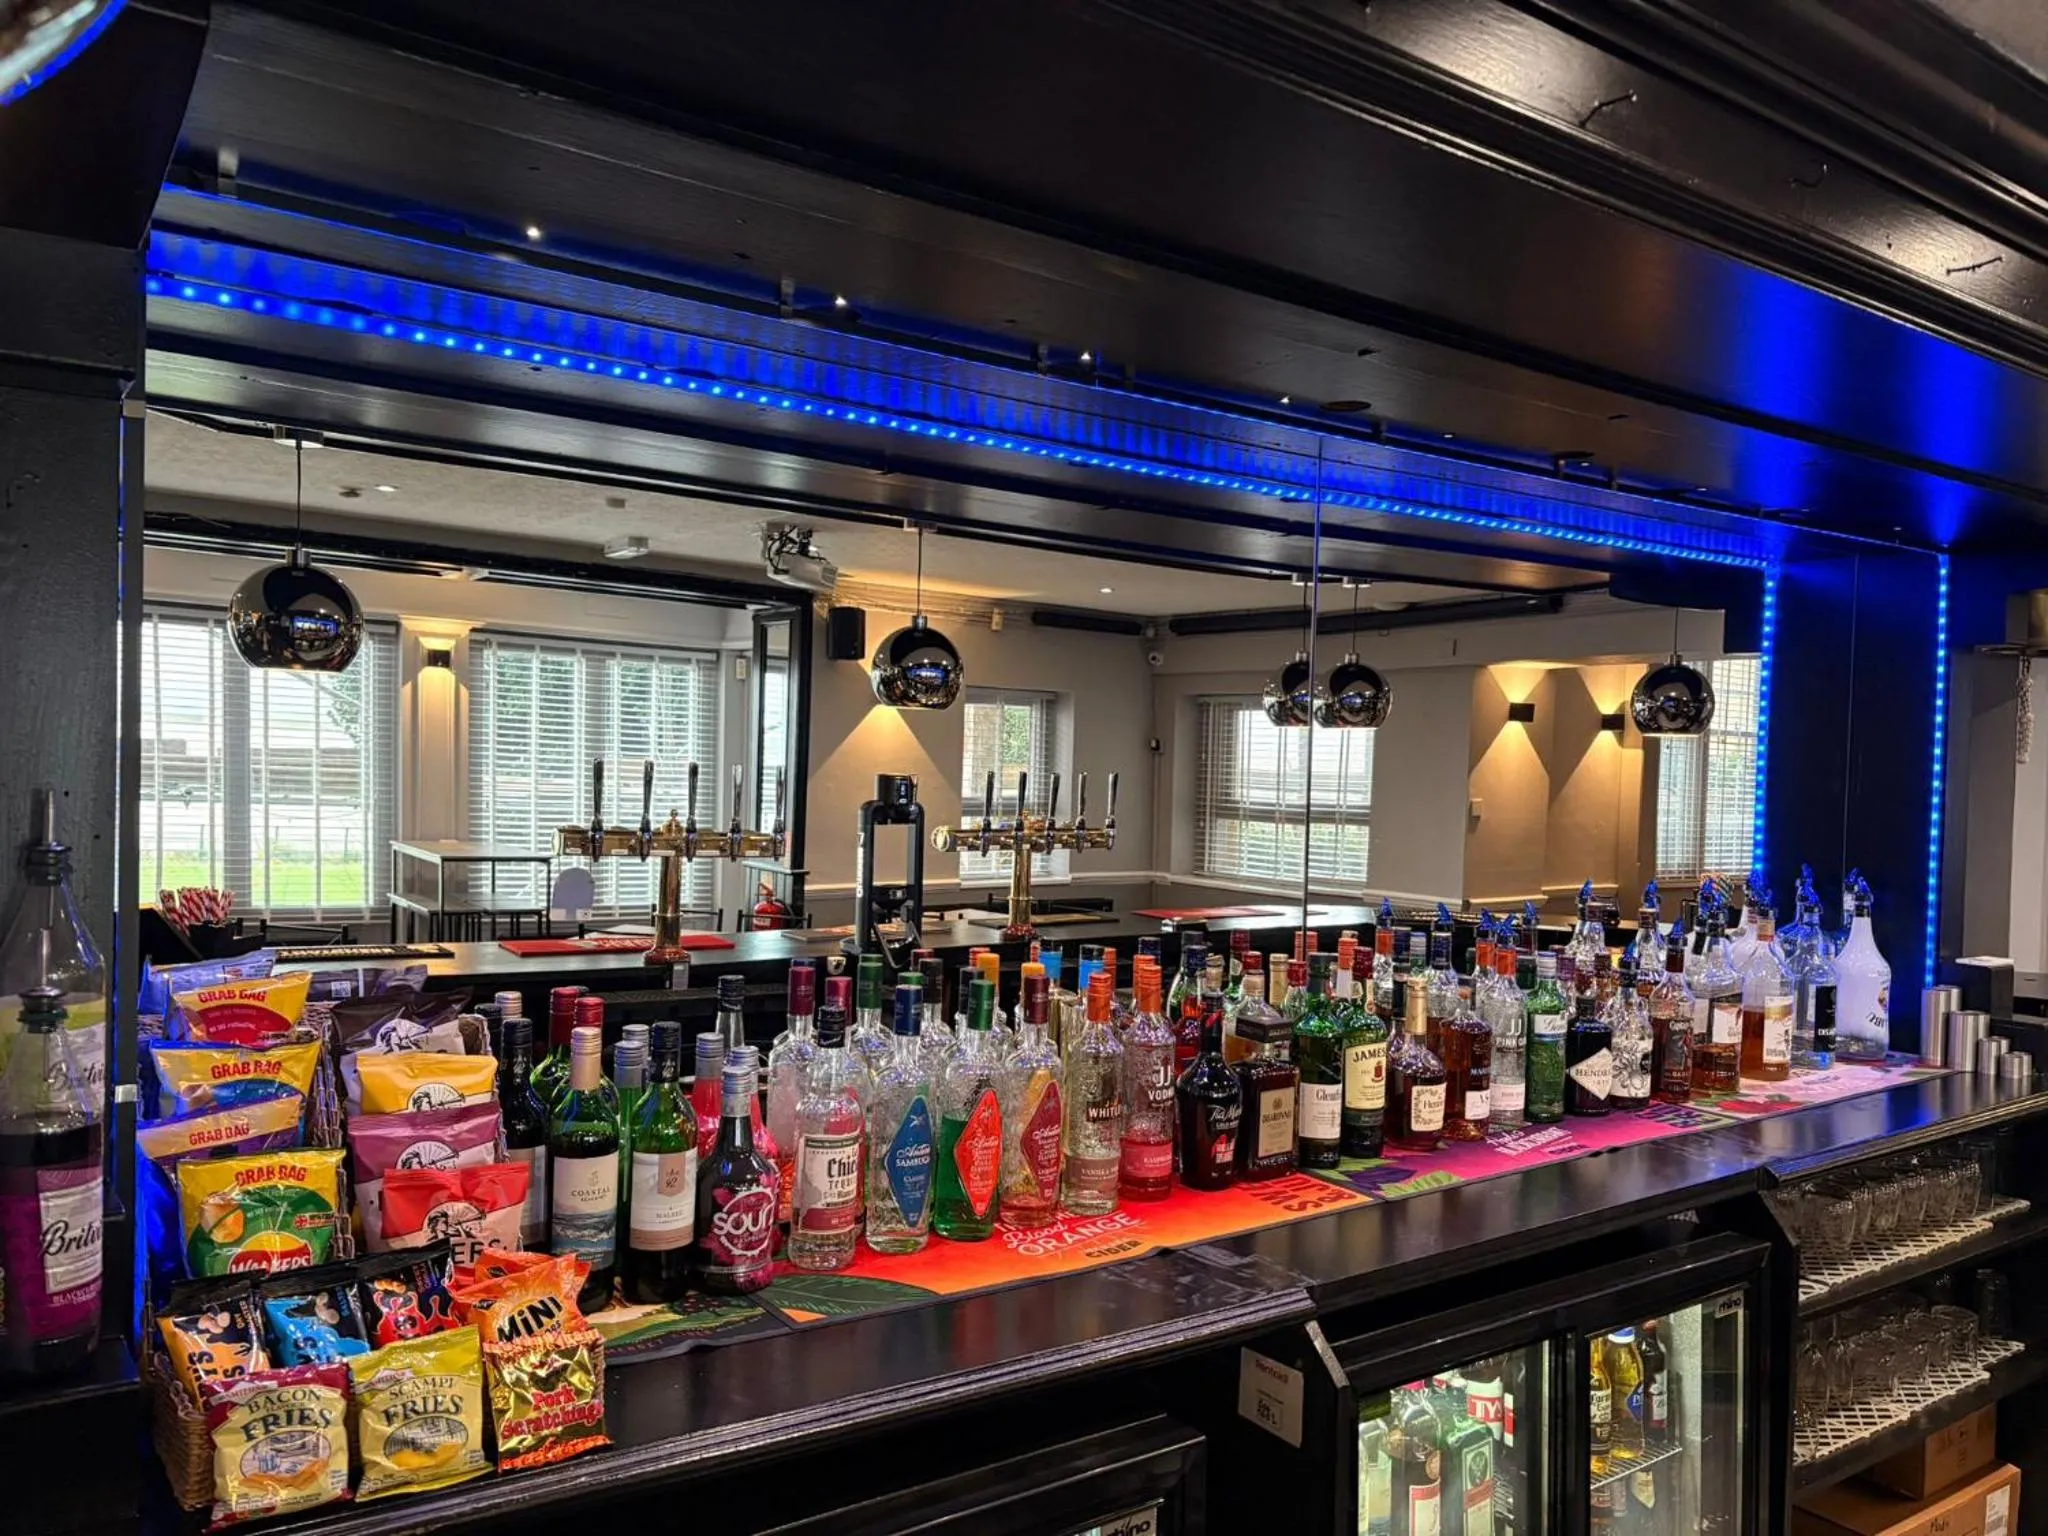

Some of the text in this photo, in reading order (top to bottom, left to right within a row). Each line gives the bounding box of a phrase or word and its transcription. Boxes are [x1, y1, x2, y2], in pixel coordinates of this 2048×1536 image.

[198, 989, 237, 1003] GRAB
[211, 1061, 250, 1079] GRAB
[189, 1123, 250, 1146] GRAB BAG
[234, 1164, 307, 1187] GRAB BAG
[1002, 1220, 1069, 1249] Blood
[1017, 1212, 1142, 1256] ORANGE
[1085, 1240, 1143, 1258] CIDER
[389, 1376, 454, 1400] SCAMPI
[531, 1383, 577, 1412] Pork
[247, 1388, 321, 1414] BACON
[382, 1393, 464, 1427] FRIES
[241, 1407, 333, 1443] FRIES
